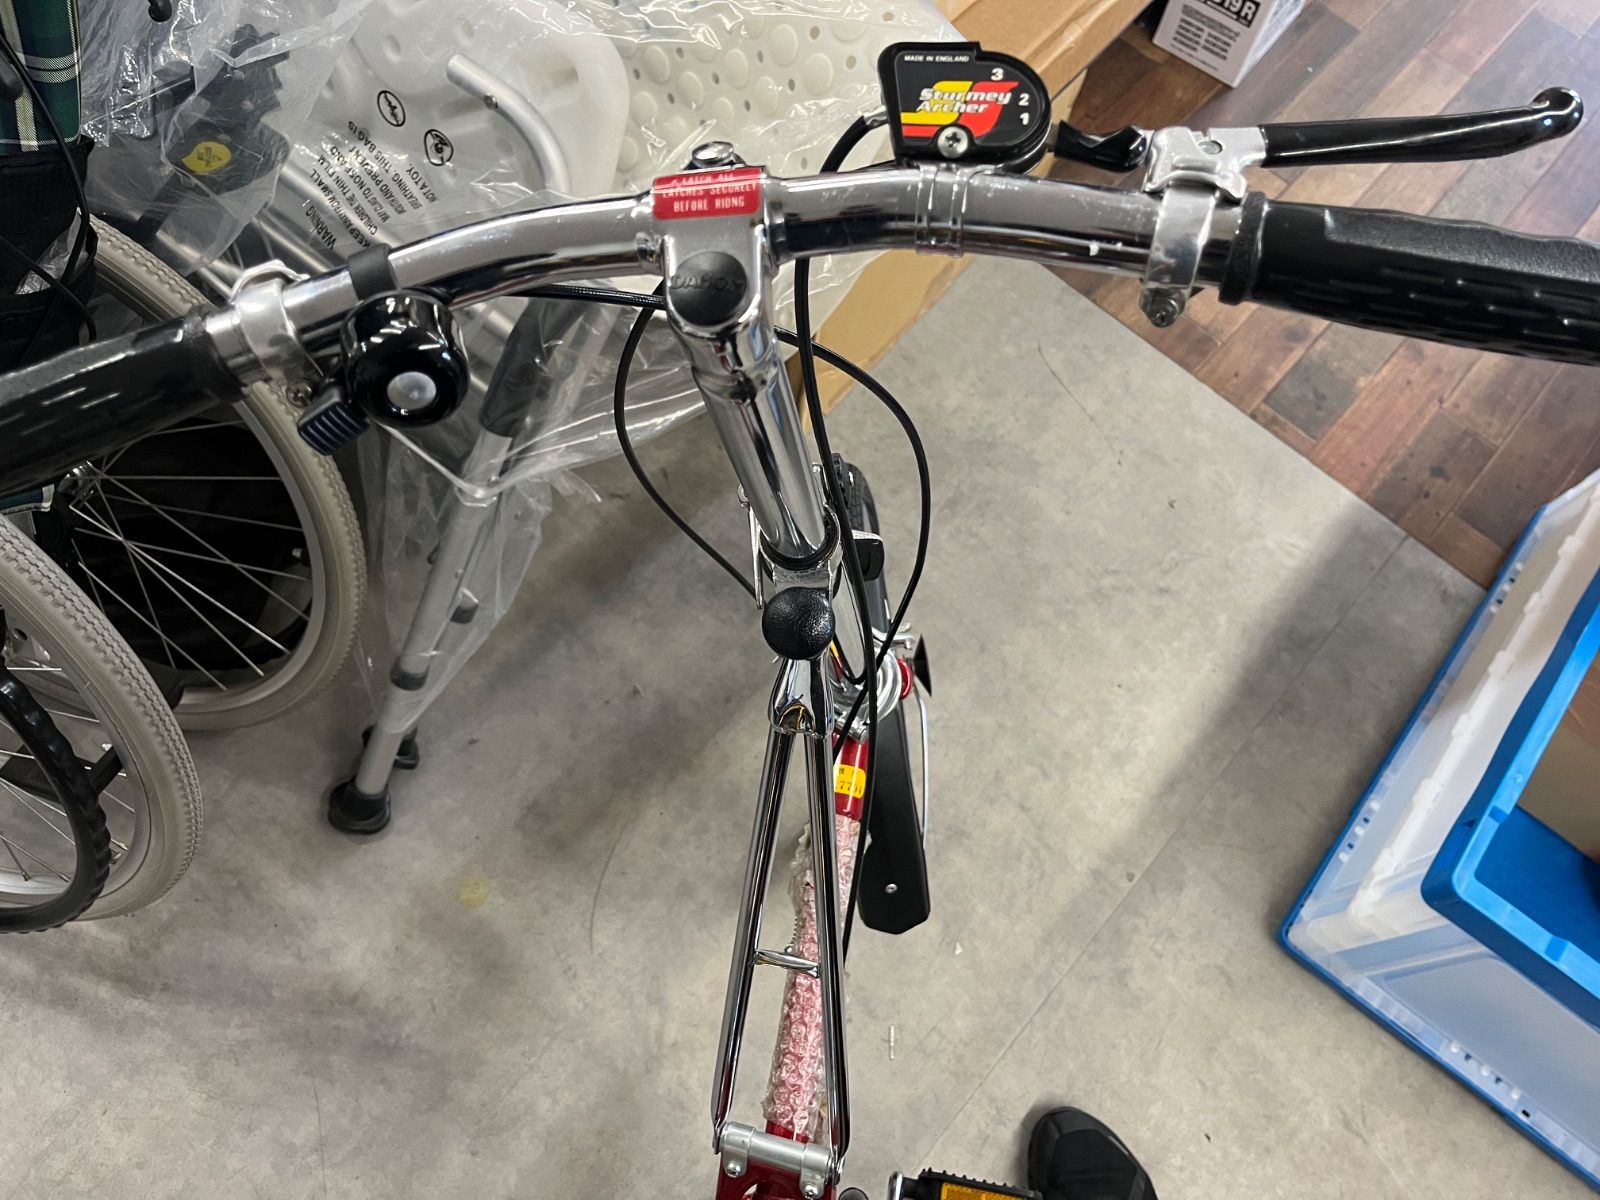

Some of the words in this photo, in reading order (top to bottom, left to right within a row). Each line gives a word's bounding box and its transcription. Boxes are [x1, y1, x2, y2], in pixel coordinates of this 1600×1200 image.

[990, 67, 1004, 81] 3
[918, 88, 1013, 105] Sturmey
[1018, 93, 1030, 106] 2
[916, 100, 989, 113] Archer
[347, 120, 358, 133] IS
[1020, 112, 1030, 125] 1
[356, 130, 376, 152] BAG
[317, 154, 336, 177] FILM
[373, 149, 392, 173] THIS
[310, 168, 333, 197] SMALL
[332, 174, 350, 196] THIN
[378, 182, 395, 199] AND
[361, 186, 373, 199] TO
[421, 187, 439, 203] NOT
[672, 198, 708, 213] BEFORE
[303, 205, 336, 250] WARNING
[348, 226, 371, 248] KEEP
